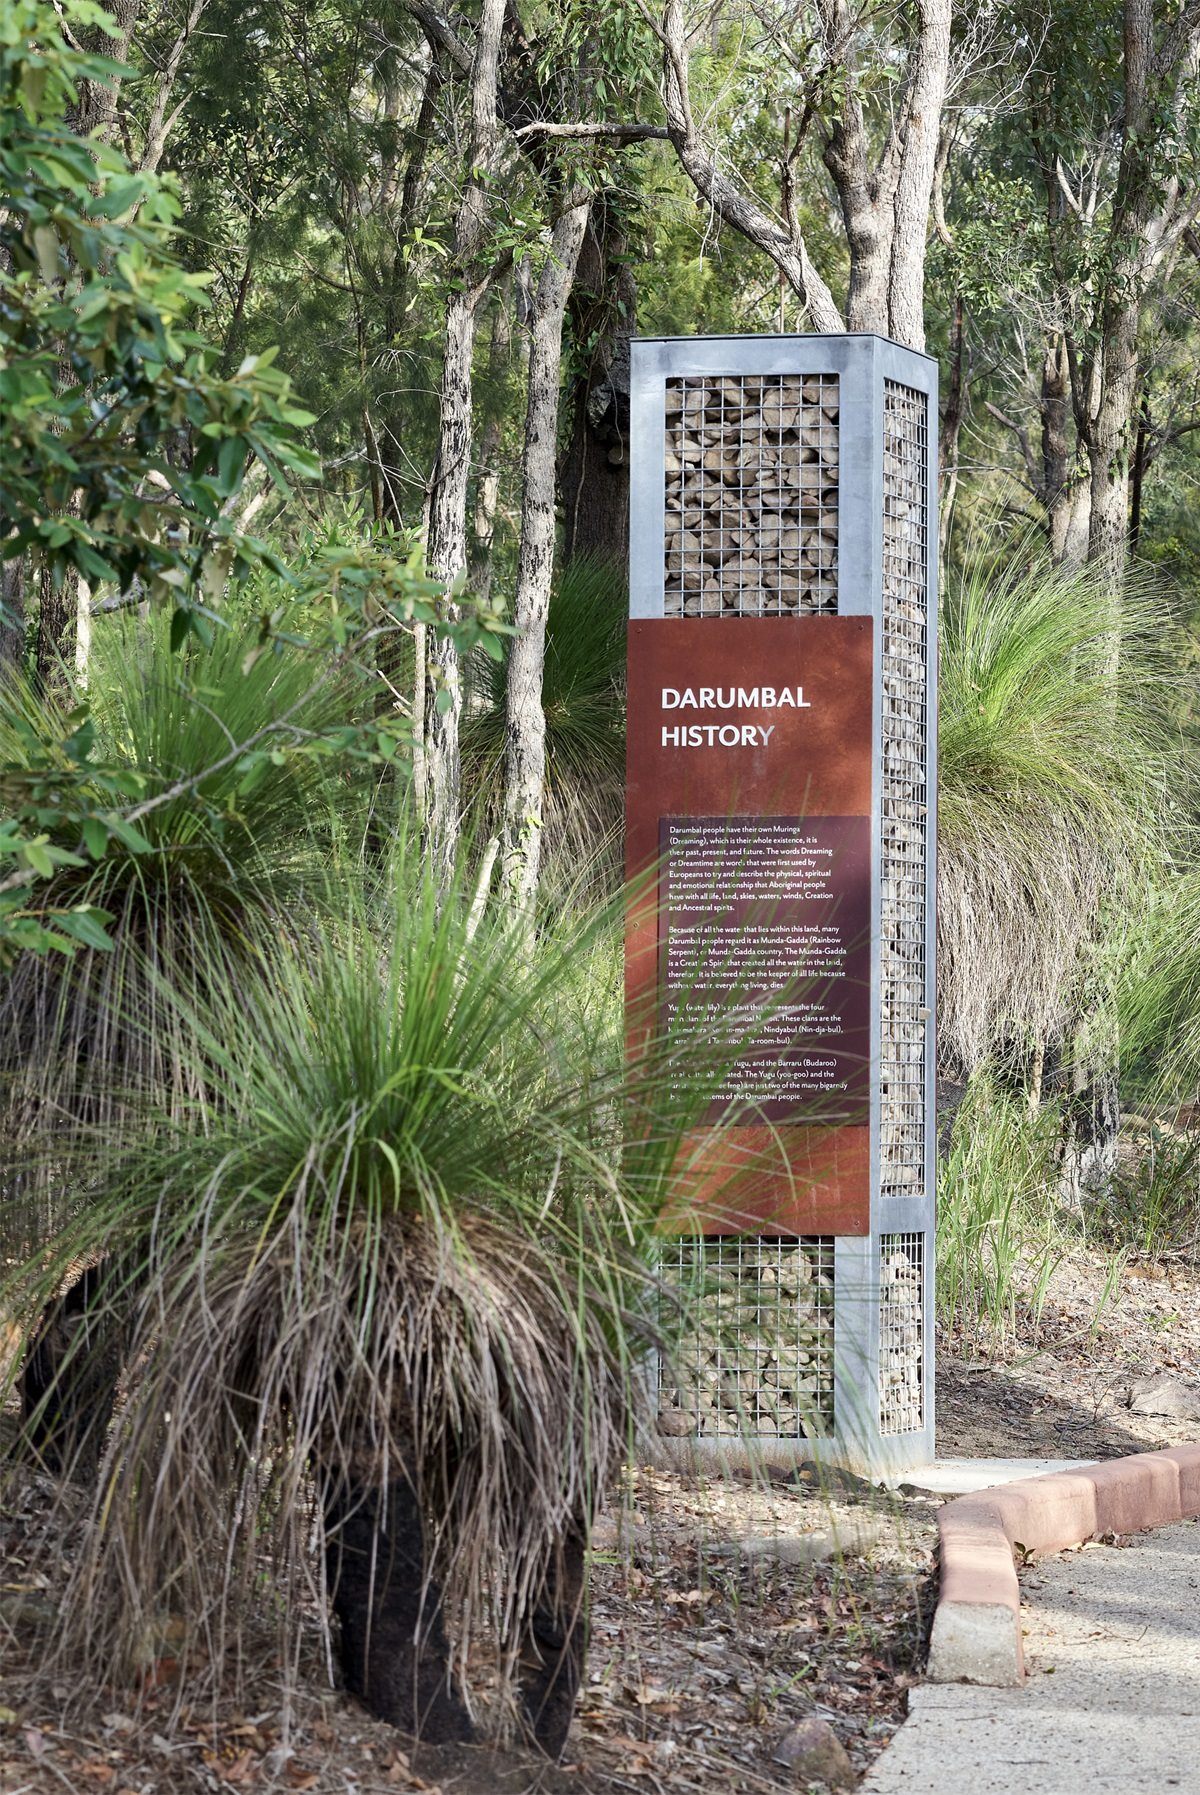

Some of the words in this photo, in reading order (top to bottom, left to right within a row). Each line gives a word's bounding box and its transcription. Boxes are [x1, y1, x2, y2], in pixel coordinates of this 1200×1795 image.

[662, 687, 811, 709] DARUMBAL
[662, 725, 775, 747] HISTORY
[703, 826, 725, 835] people
[670, 837, 708, 846] (Dreaming),
[801, 848, 832, 856] Dreaming
[808, 859, 816, 867] by
[670, 871, 703, 879] Europeans
[776, 870, 804, 879] physical,
[805, 870, 831, 878] spiritual
[769, 881, 802, 890] Aboriginal
[804, 881, 826, 889] people
[708, 1003, 720, 1013] lily)
[764, 1026, 797, 1035] Nindyabul
[799, 1026, 843, 1035] (Nin-dja-bul),
[759, 1071, 775, 1079] Yugu
[777, 1070, 809, 1079] (yoo-goo)
